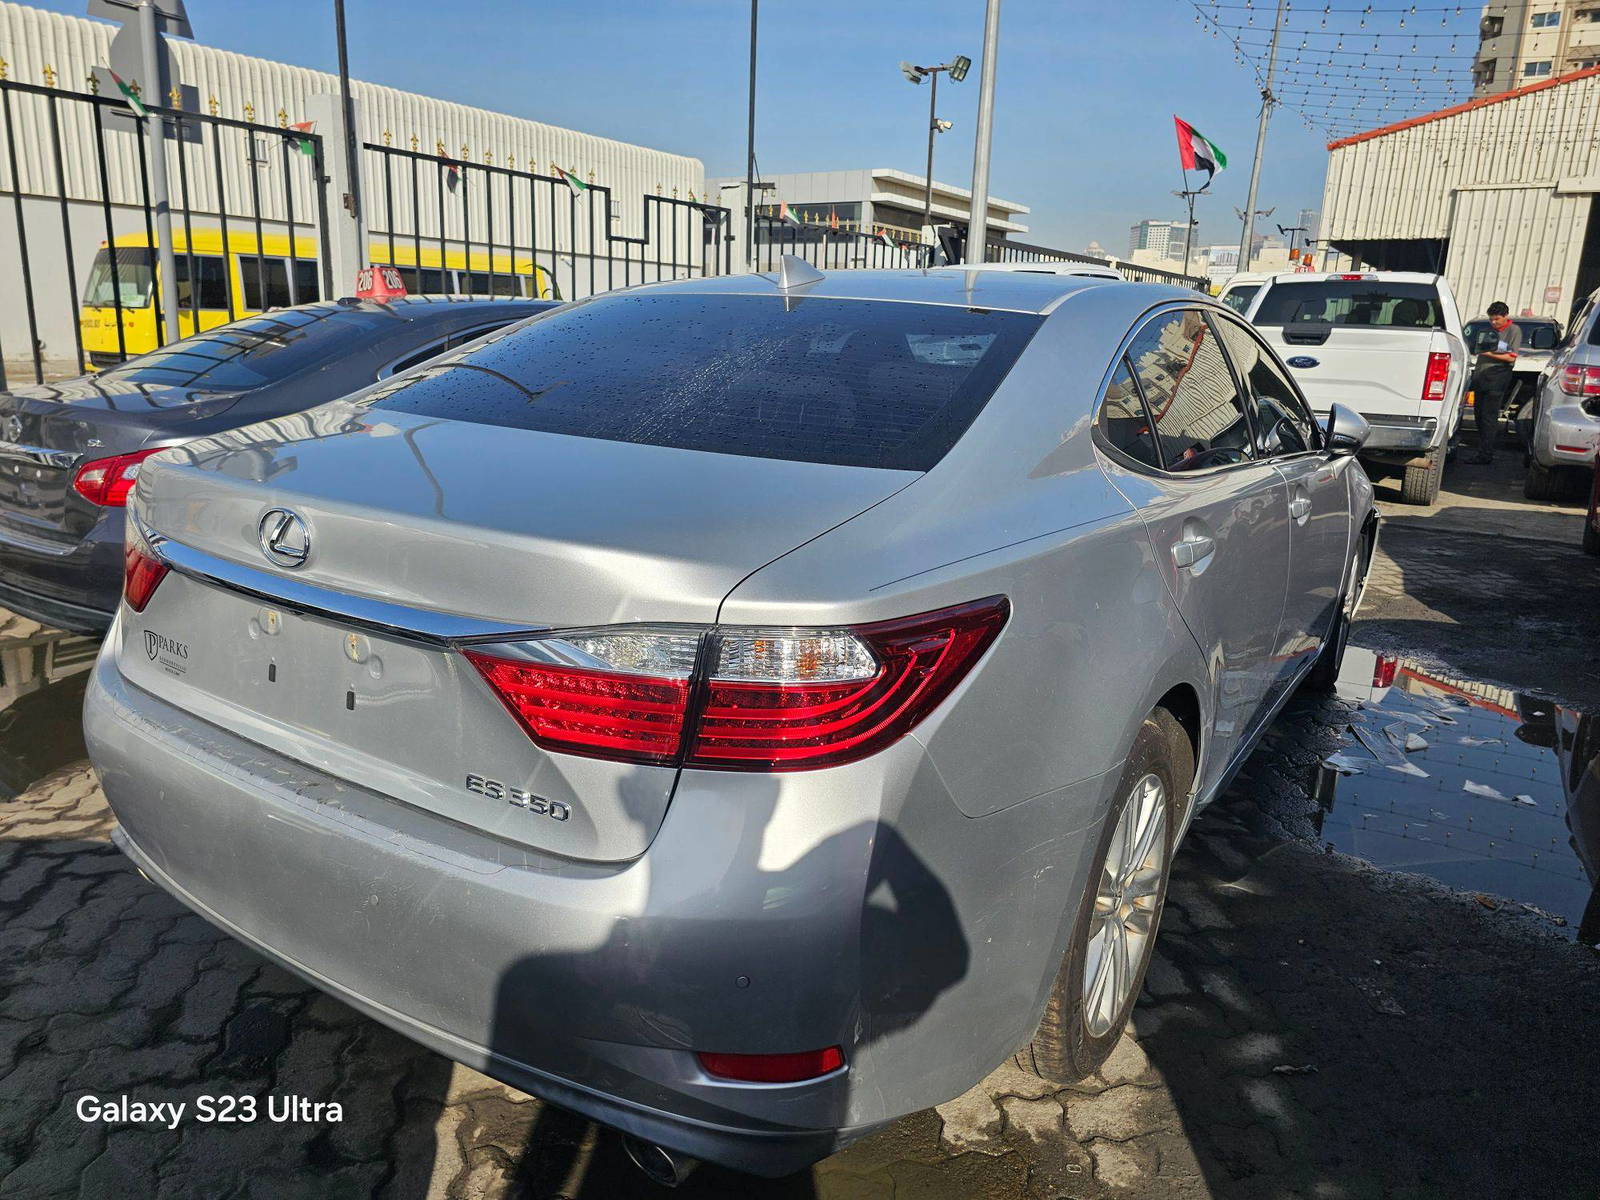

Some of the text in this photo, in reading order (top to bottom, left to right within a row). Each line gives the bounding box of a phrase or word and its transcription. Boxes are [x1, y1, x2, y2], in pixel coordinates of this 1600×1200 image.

[358, 270, 373, 291] 206
[382, 269, 403, 289] 206
[158, 635, 188, 660] PARKS
[465, 773, 572, 822] ES 350
